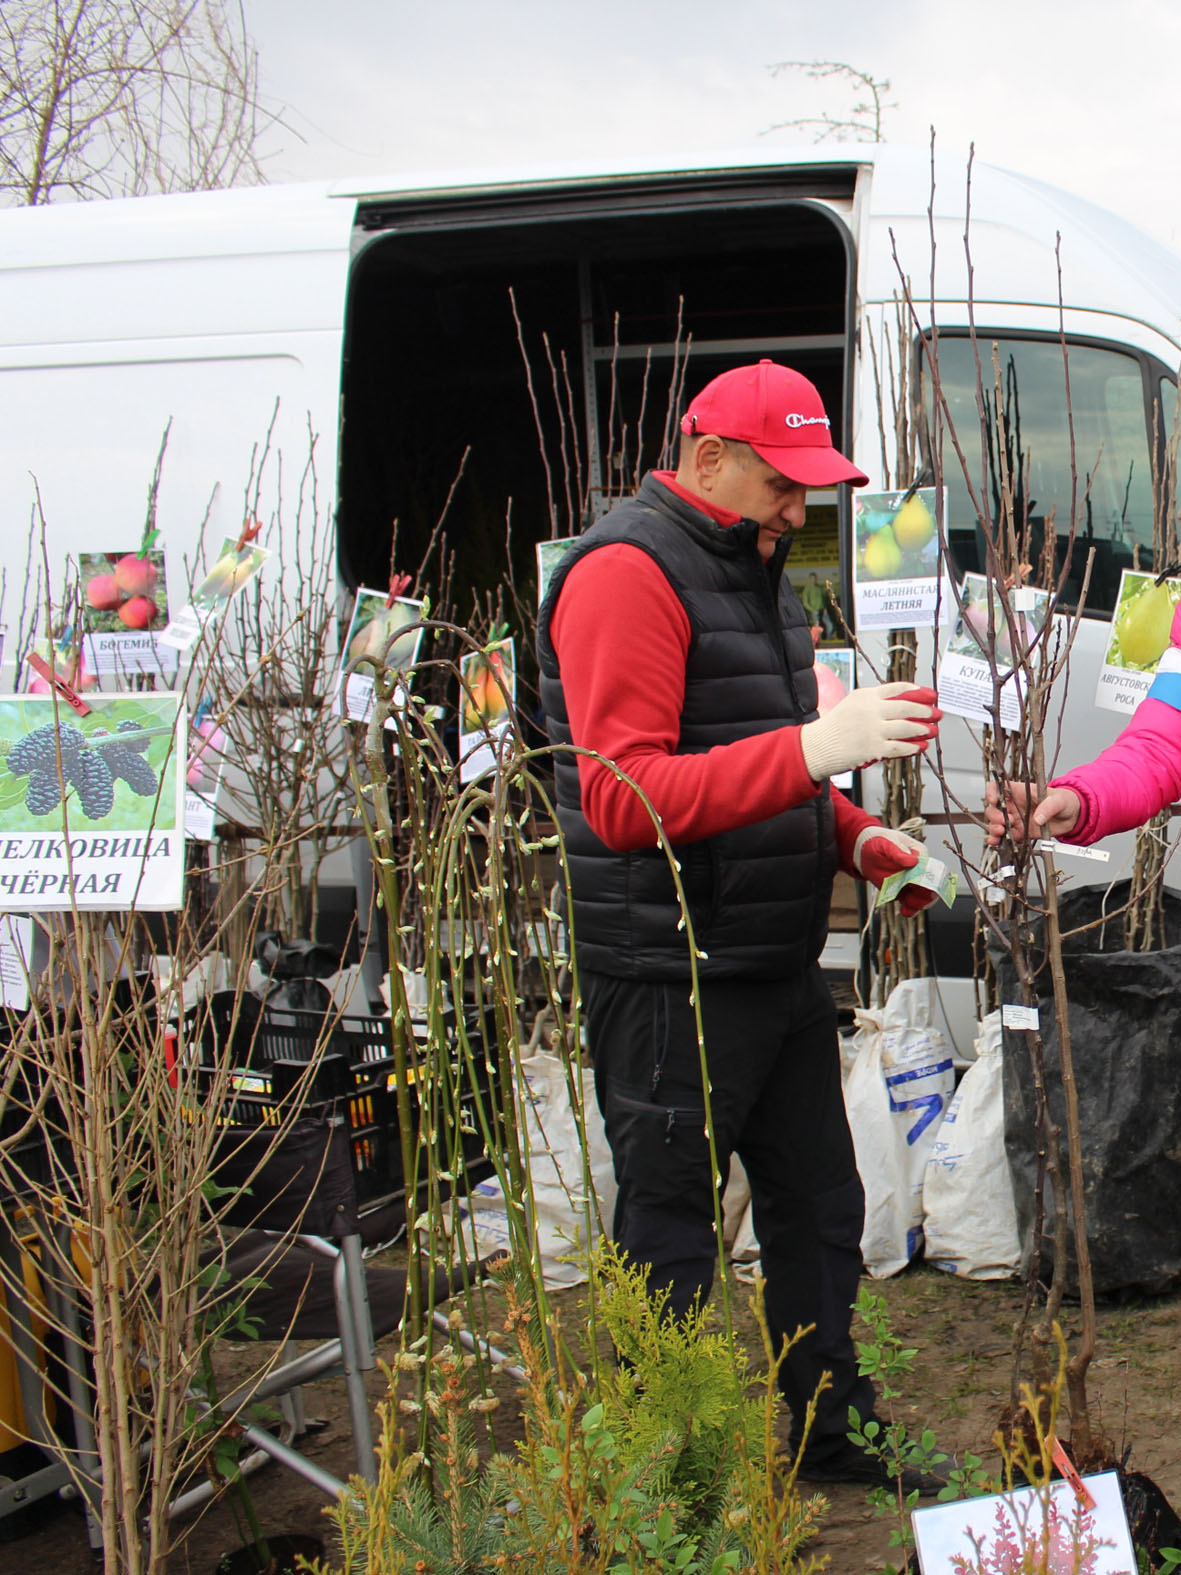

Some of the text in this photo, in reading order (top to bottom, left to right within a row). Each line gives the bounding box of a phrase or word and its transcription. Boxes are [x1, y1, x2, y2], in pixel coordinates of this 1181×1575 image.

[880, 599, 923, 611] ЛЕТНЯЯ
[1114, 692, 1135, 706] РОСА
[0, 837, 171, 861] ЕЛКОВИЦА
[1, 870, 122, 895] ЧЁРНАЯ
